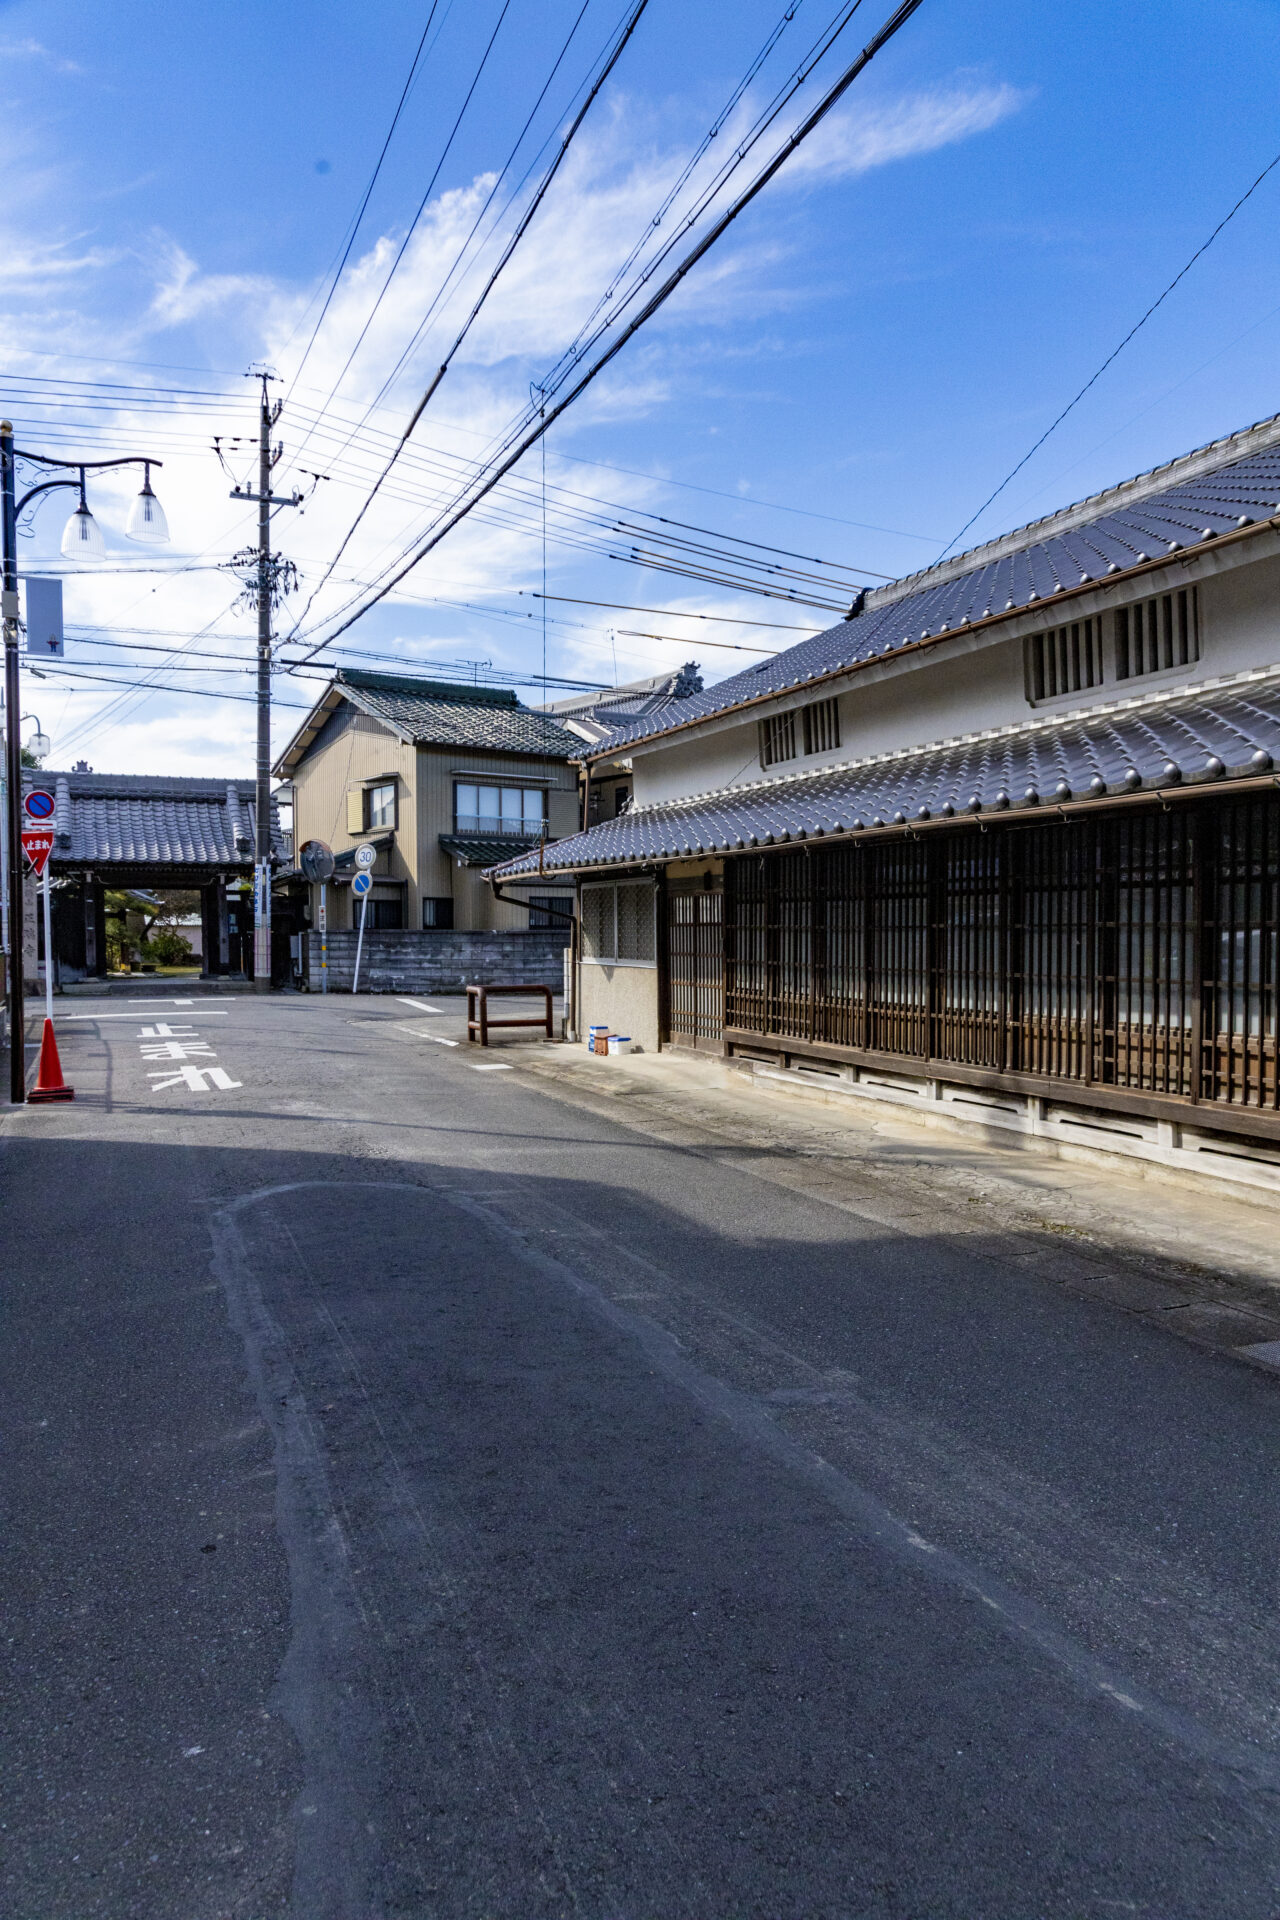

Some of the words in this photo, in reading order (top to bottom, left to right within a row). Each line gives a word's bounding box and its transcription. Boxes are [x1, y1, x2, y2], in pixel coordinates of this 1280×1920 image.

[27, 840, 50, 851] 止まれ
[360, 852, 371, 862] 30
[136, 1023, 243, 1092] 止まれ
